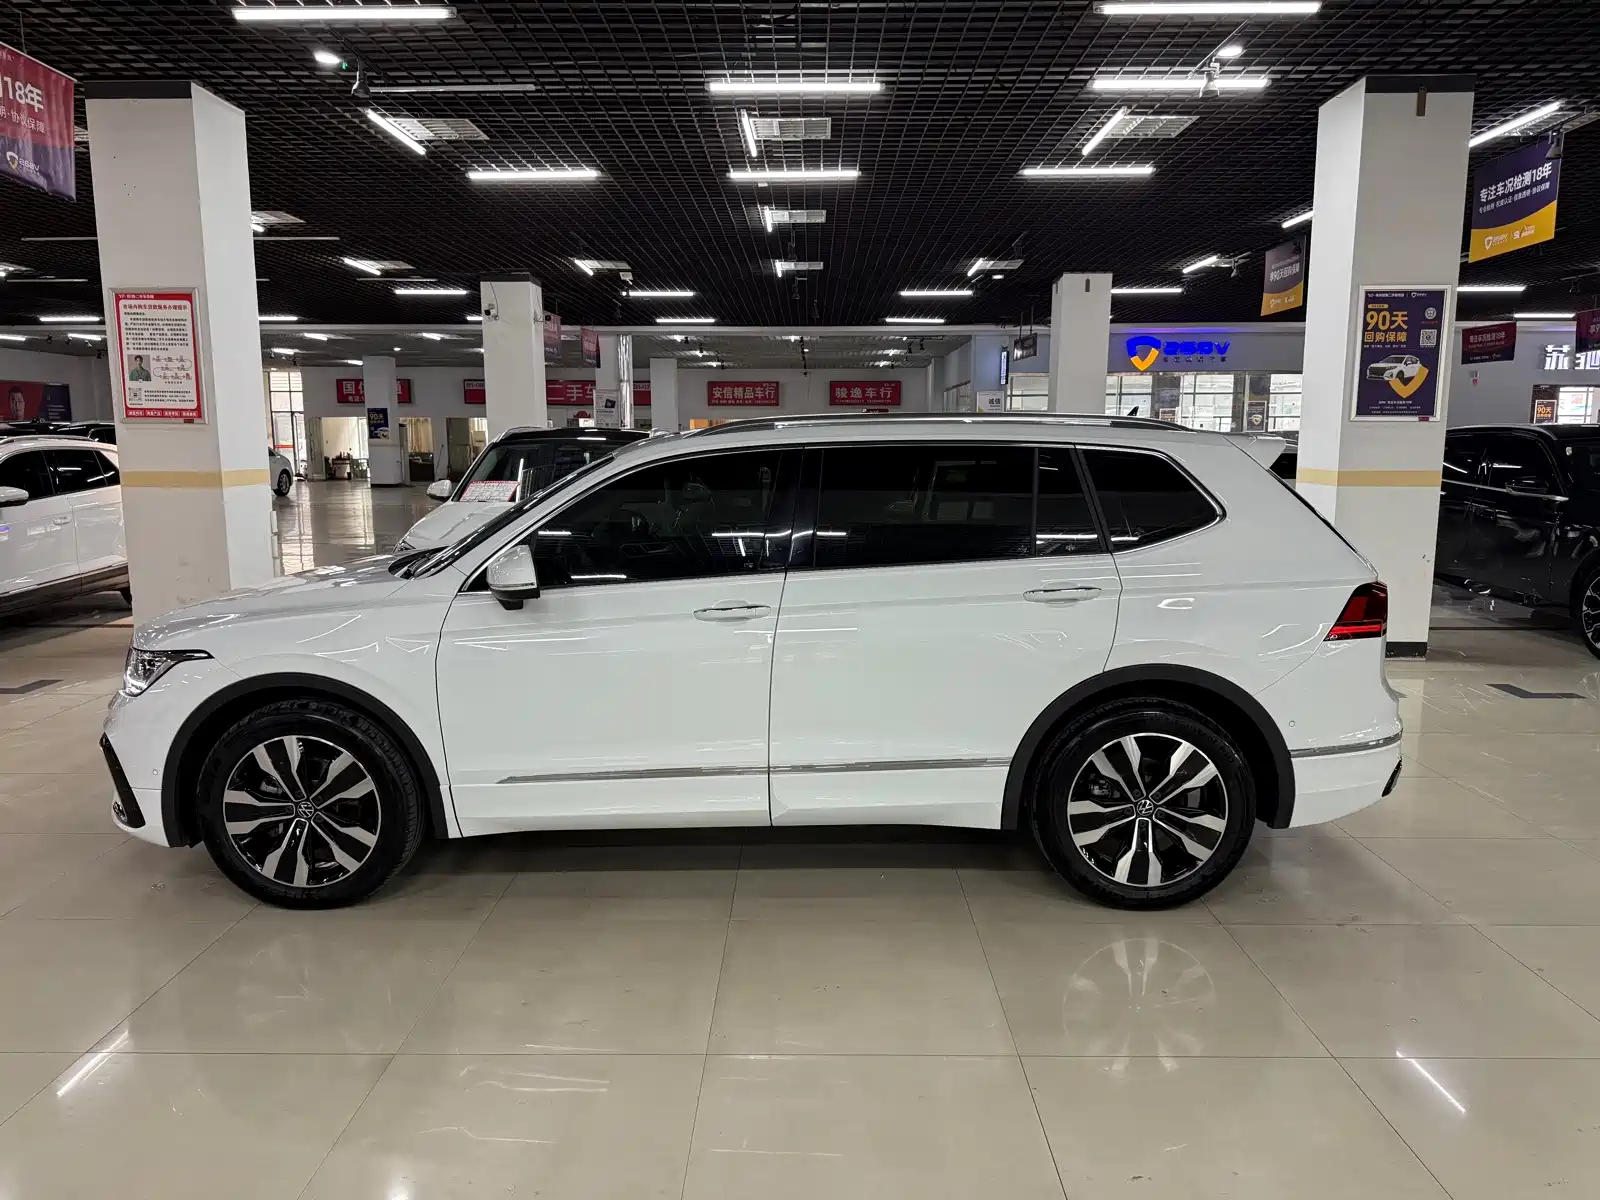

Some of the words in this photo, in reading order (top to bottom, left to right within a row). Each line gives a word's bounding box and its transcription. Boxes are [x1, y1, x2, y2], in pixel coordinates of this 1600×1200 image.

[1480, 162, 1552, 202] 专注车况检测18年
[1366, 310, 1408, 330] 90天
[1364, 331, 1407, 343] 回购保障
[712, 386, 776, 399] 安信精品车行
[835, 387, 893, 398] 骏逸车行
